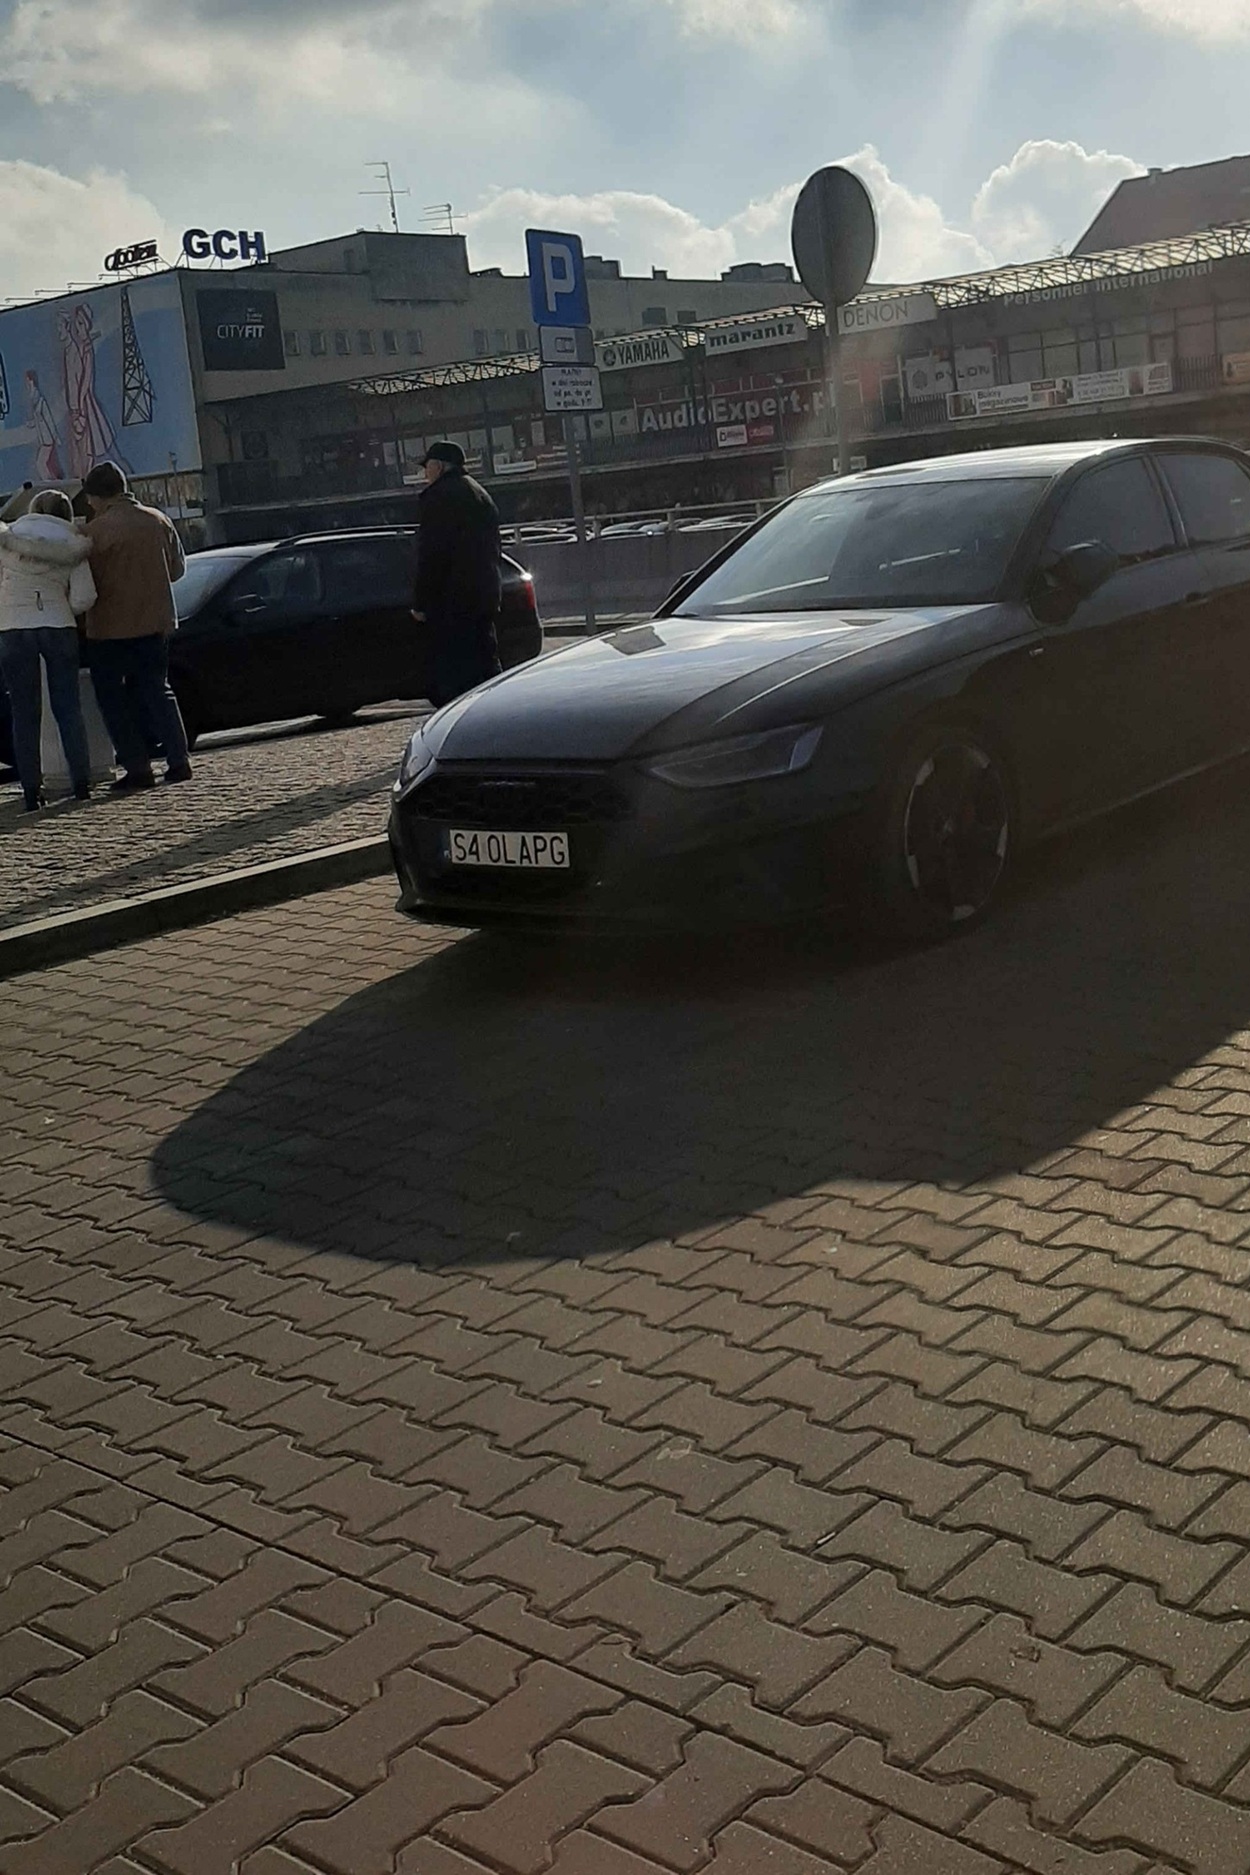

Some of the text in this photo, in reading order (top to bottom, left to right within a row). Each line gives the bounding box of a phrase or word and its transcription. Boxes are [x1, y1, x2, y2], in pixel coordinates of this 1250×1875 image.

[183, 229, 266, 261] GCH
[542, 242, 575, 312] P
[1004, 260, 1214, 307] Personnel International
[843, 300, 909, 328] DENON
[217, 324, 265, 338] CITYFIT
[709, 321, 797, 348] marantz
[617, 339, 670, 365] YAMAHA
